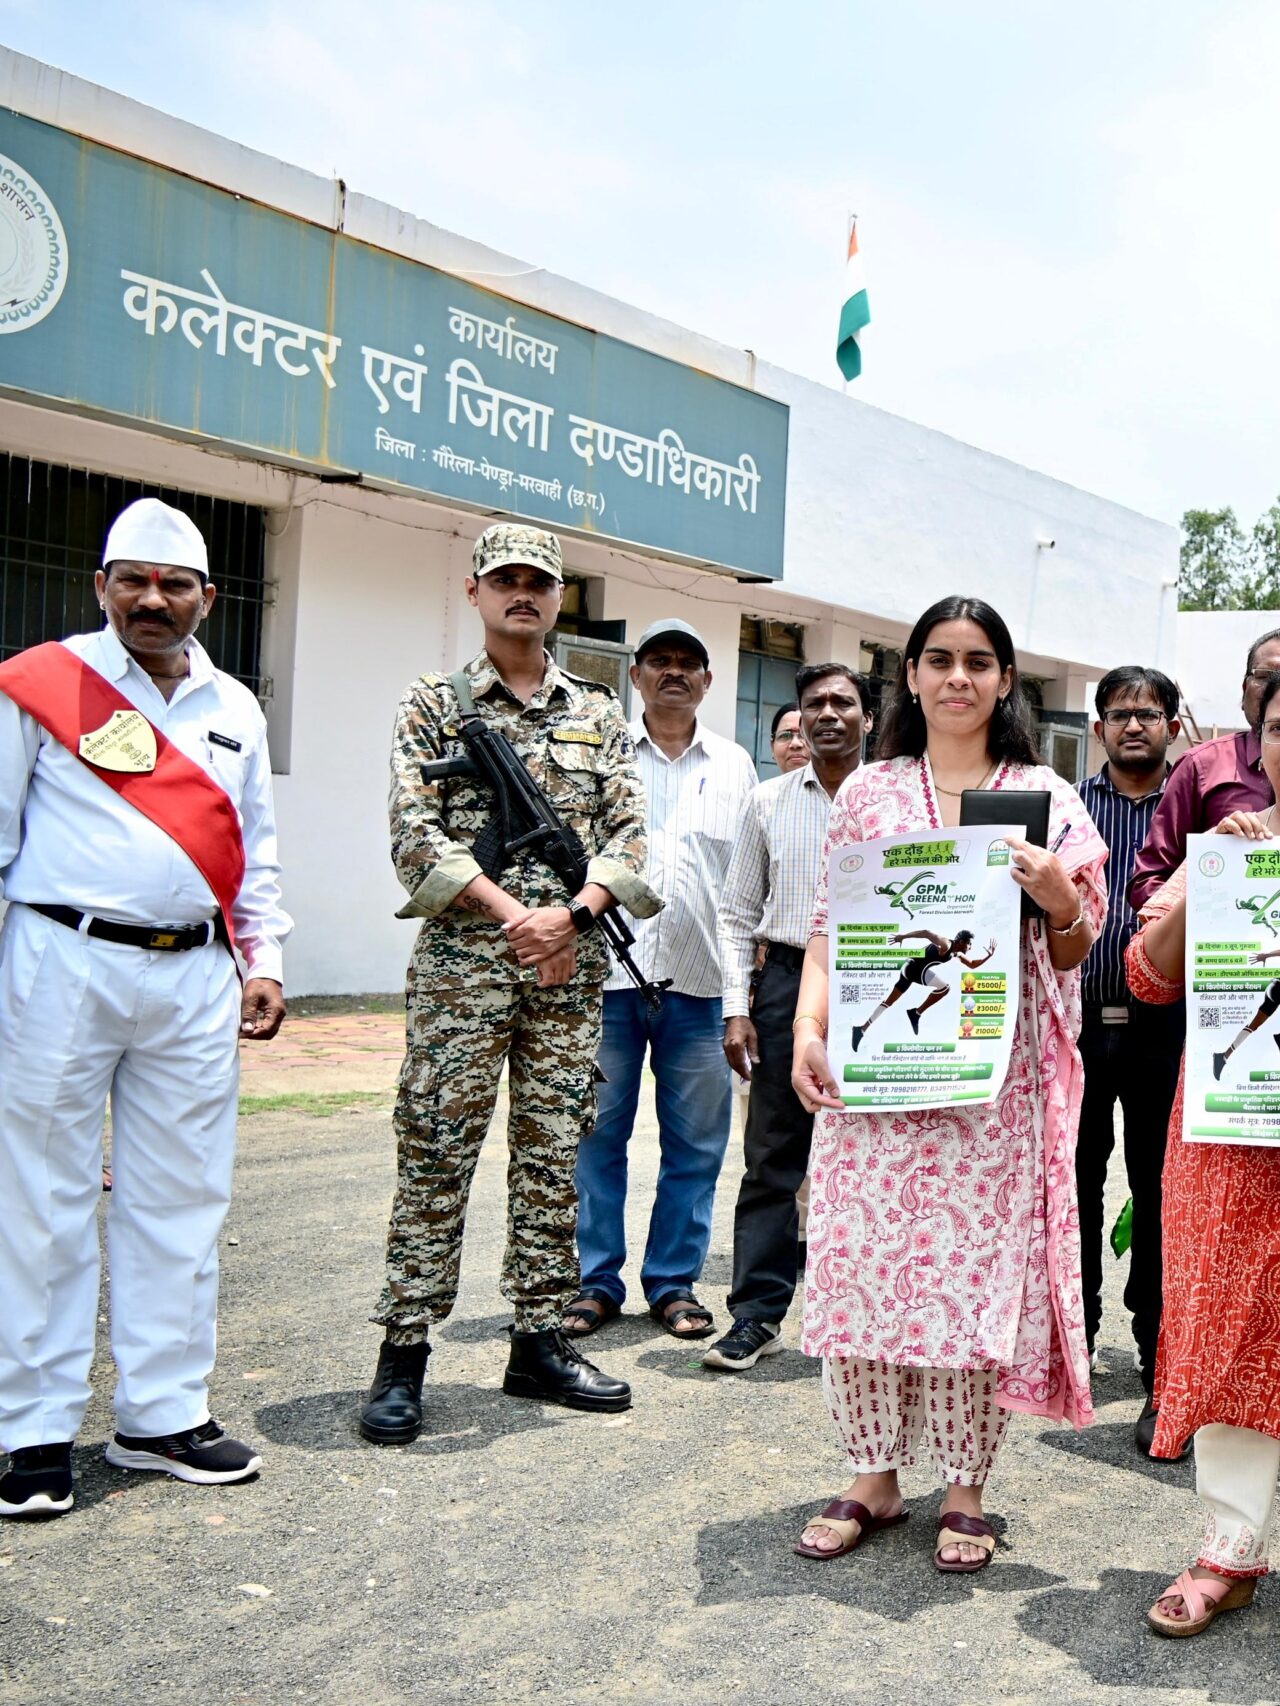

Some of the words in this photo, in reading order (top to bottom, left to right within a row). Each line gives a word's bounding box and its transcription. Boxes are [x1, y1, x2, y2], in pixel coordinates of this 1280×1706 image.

[449, 306, 558, 375] कार्यालय
[121, 269, 341, 388] कलेक्टर
[361, 344, 428, 414] एवं
[447, 358, 554, 452] जिला
[569, 412, 761, 514] दण्डाधिकारी
[375, 427, 415, 460] जिला
[567, 484, 606, 516] (छ.ग.)
[1244, 853, 1265, 864] एक
[1252, 866, 1262, 876] हरे
[1265, 866, 1275, 875] भरे
